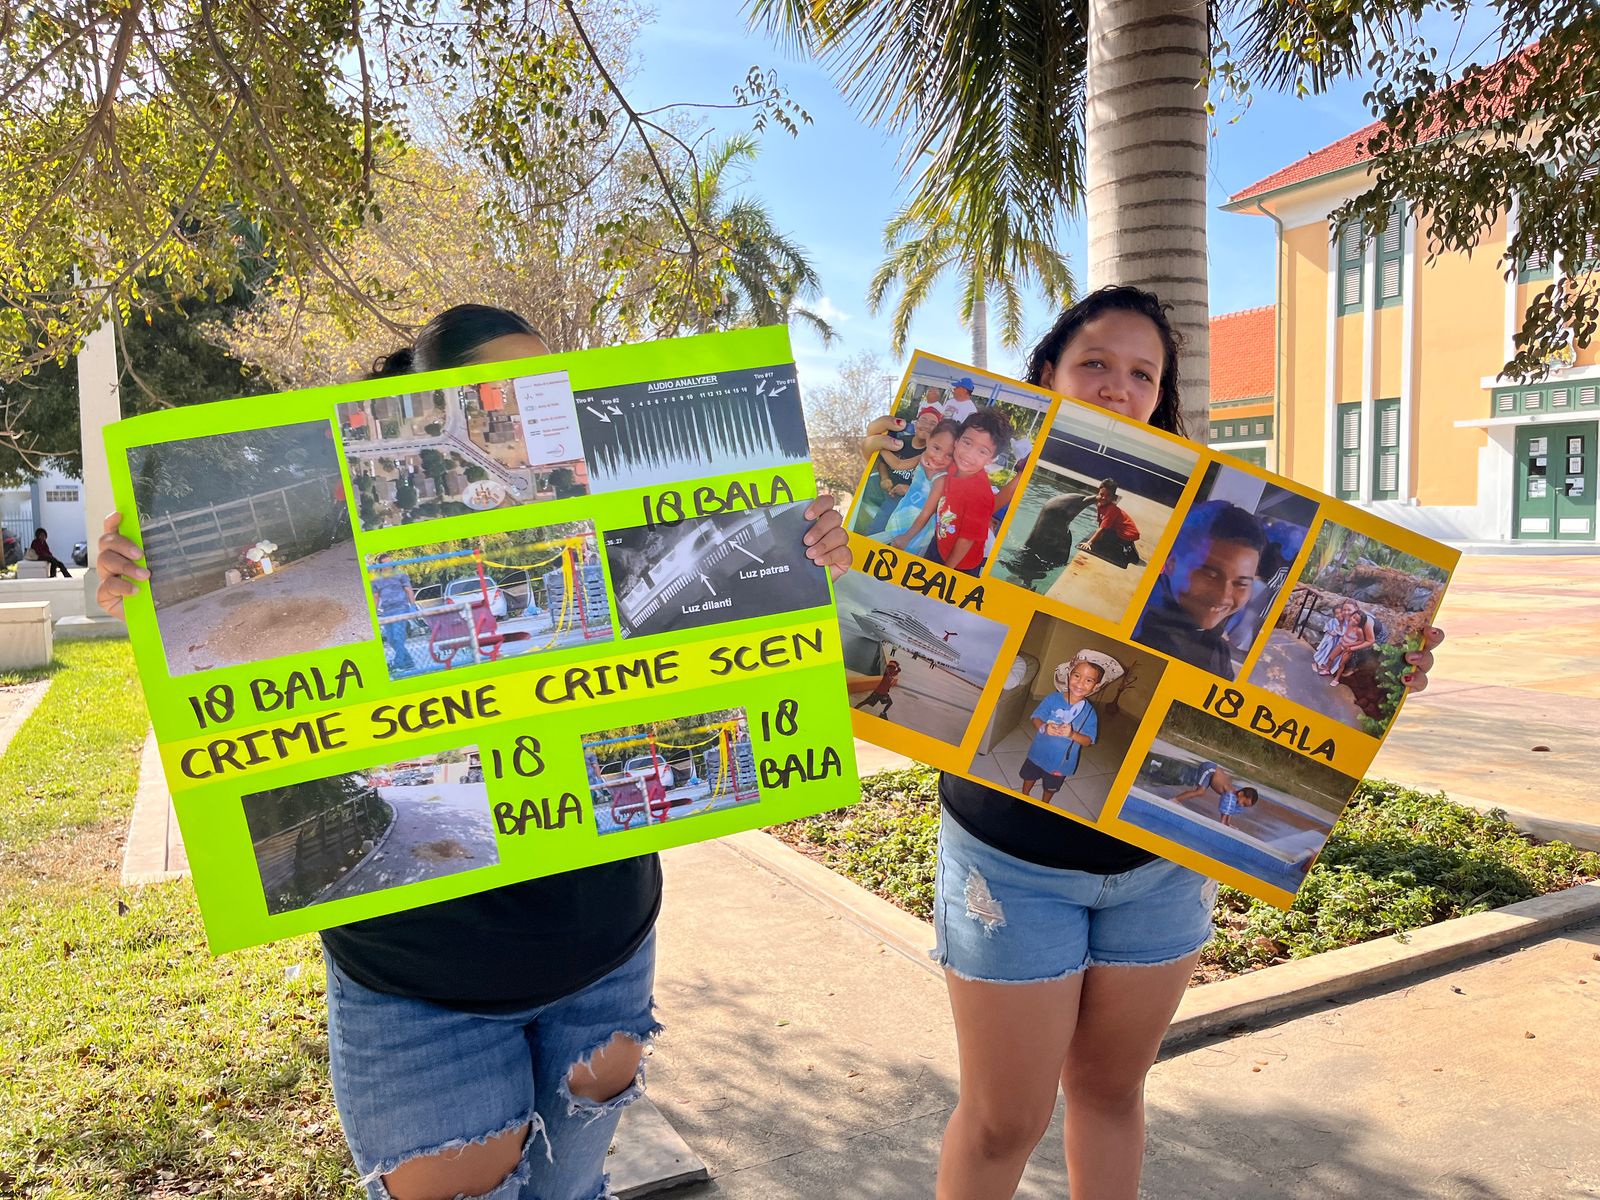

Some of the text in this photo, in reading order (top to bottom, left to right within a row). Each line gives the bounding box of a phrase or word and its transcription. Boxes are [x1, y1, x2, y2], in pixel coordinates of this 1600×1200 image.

[647, 375, 718, 391] AUDIO ANALYZER
[694, 475, 794, 516] BALA
[739, 564, 790, 580] Luz patras
[862, 548, 985, 611] 18 BALA
[682, 598, 732, 614] Luz dilanti
[180, 628, 823, 779] CRIME SCENE CRIME SCEN
[250, 659, 364, 712] BALA
[761, 699, 799, 741] 18
[1202, 683, 1336, 761] 18 BALA
[492, 735, 545, 779] 18
[760, 746, 842, 789] BALA
[494, 792, 583, 835] BALA
